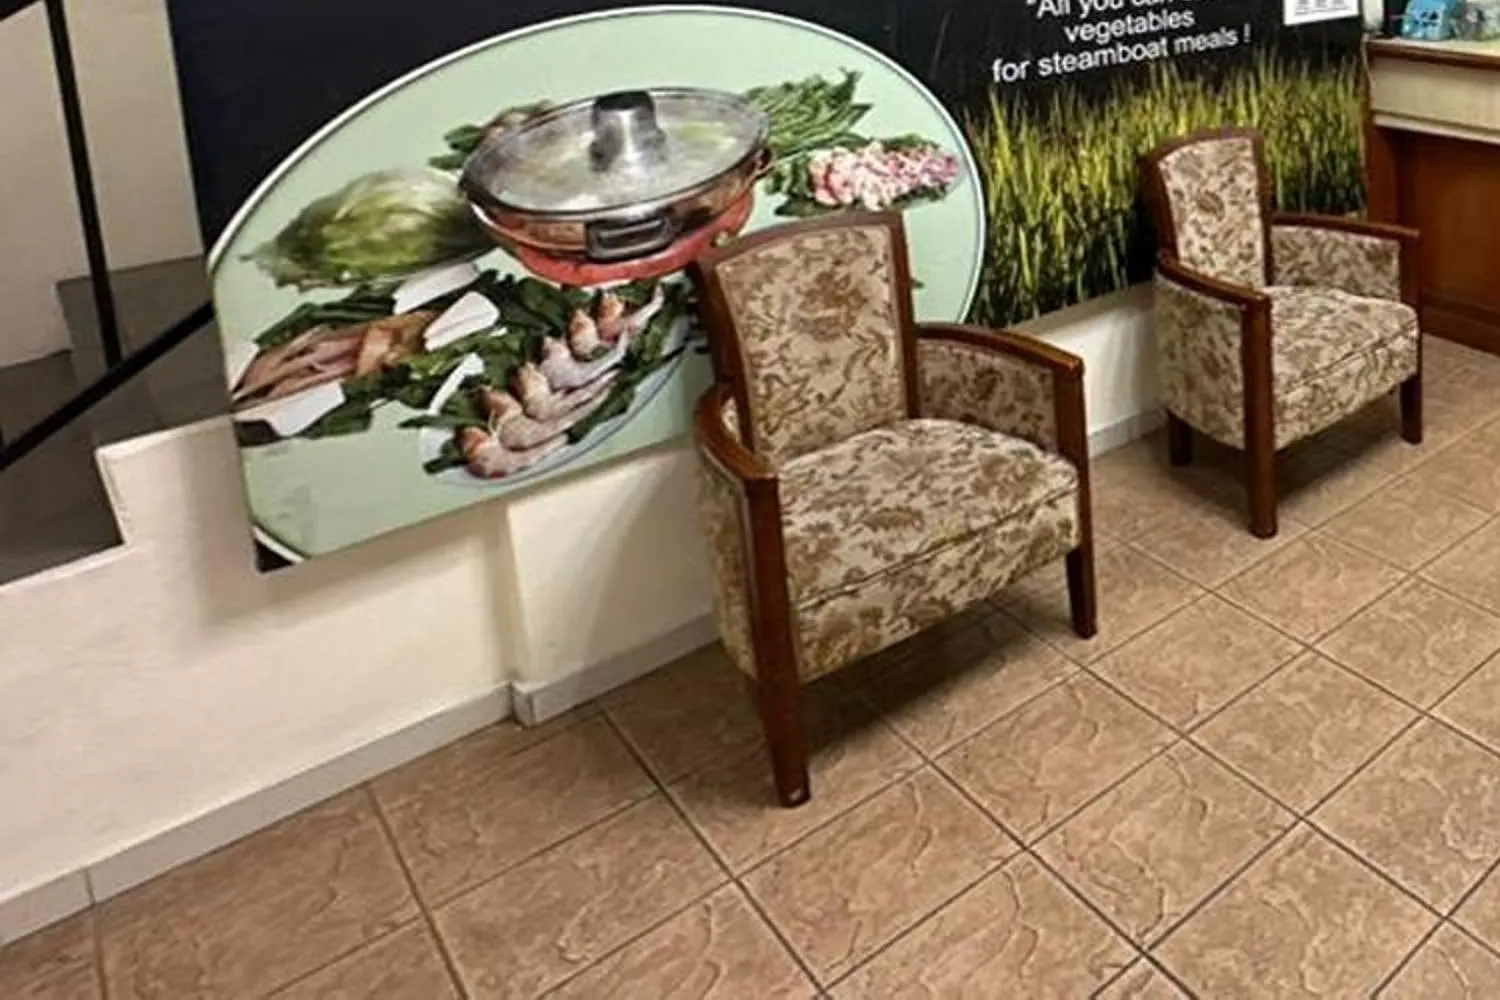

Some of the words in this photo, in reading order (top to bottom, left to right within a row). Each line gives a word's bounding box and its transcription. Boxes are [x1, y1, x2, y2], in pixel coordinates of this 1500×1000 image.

[1064, 8, 1196, 45] vegetables
[992, 58, 1031, 83] for
[1037, 36, 1170, 76] steamboat
[1173, 26, 1239, 54] meals
